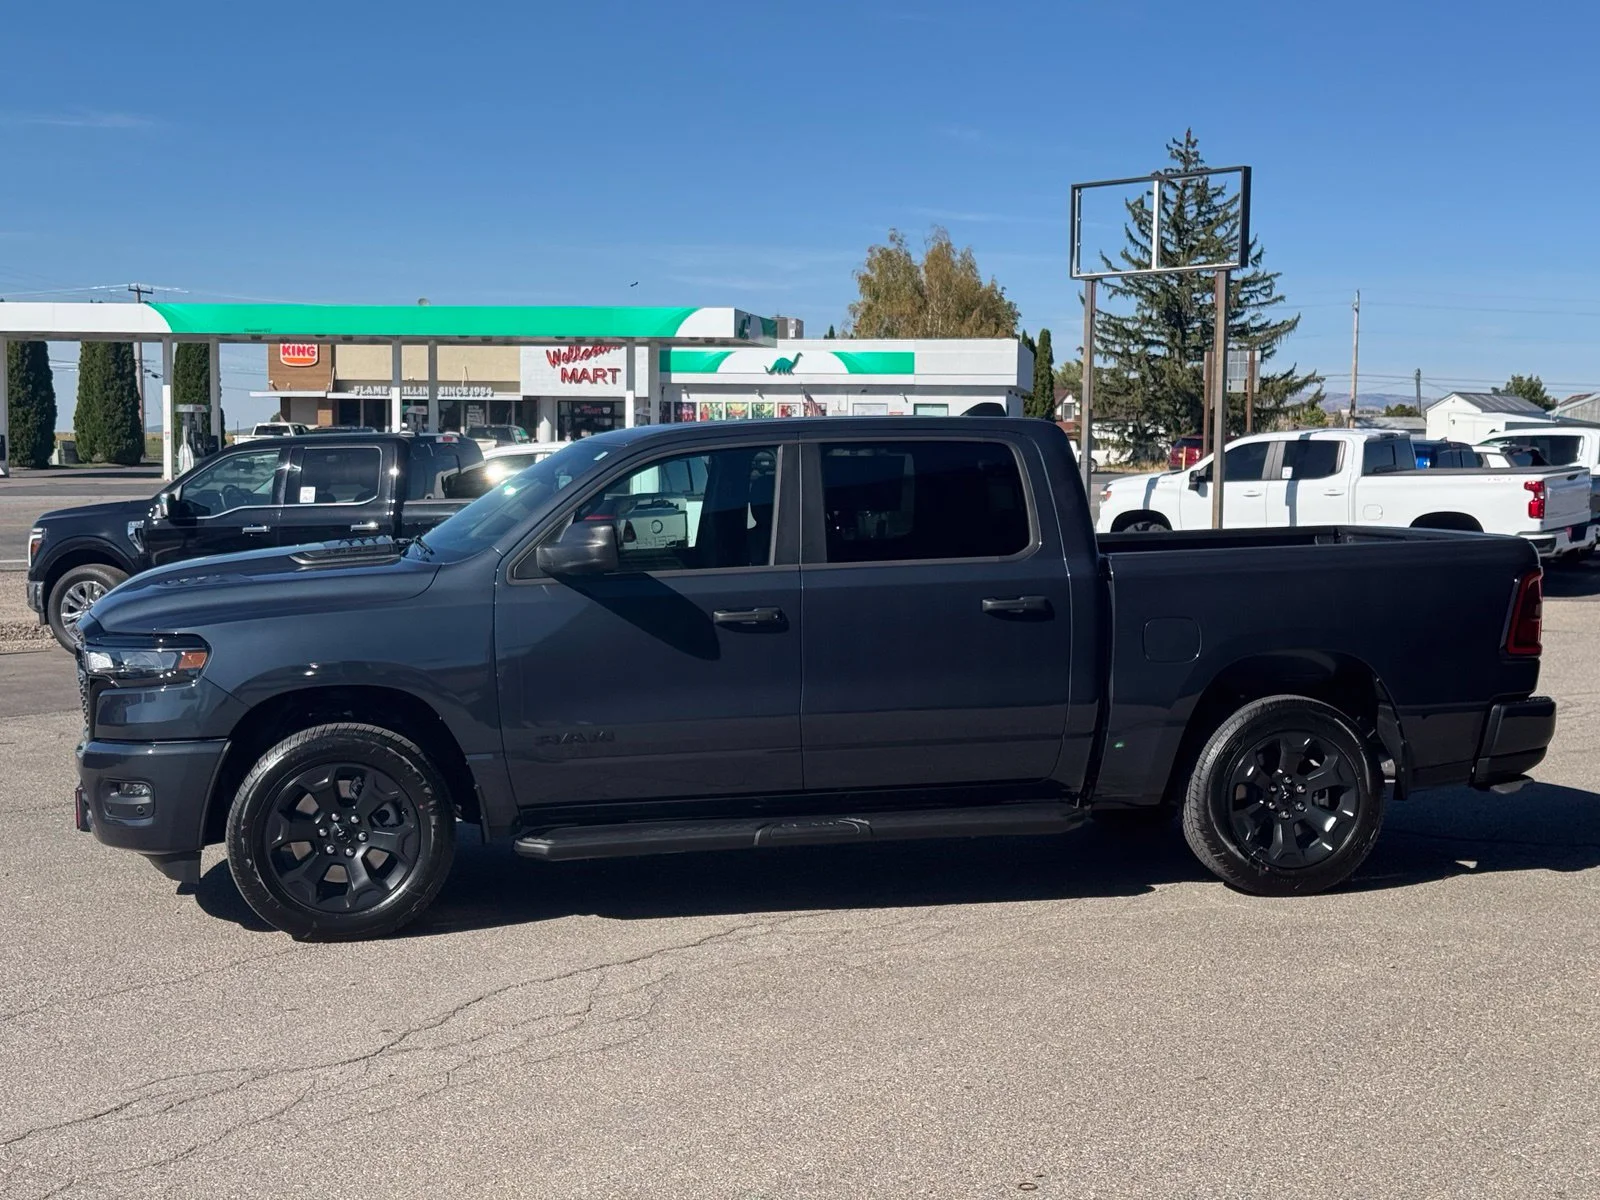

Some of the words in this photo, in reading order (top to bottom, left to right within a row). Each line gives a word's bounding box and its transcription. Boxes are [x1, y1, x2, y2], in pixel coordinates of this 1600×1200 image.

[282, 345, 316, 357] KING
[560, 367, 621, 384] MART
[354, 385, 388, 396] FLAME
[437, 386, 468, 396] SINCE
[469, 386, 493, 396] 1954
